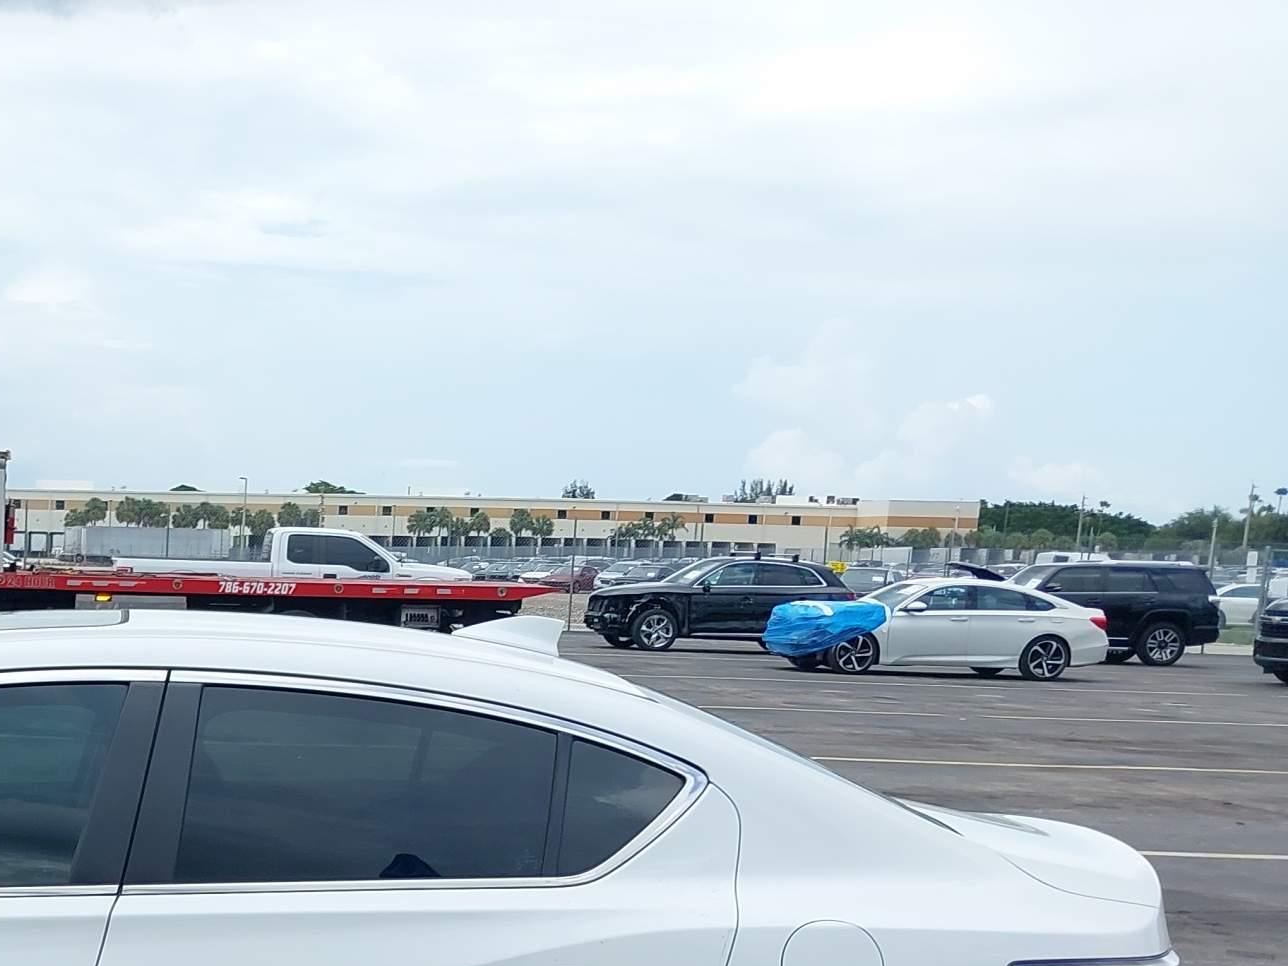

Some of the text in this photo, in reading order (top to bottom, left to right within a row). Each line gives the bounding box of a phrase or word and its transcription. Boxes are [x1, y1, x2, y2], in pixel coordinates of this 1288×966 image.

[6, 574, 56, 588] 24 HOUR
[218, 581, 297, 595] 786-670-2207
